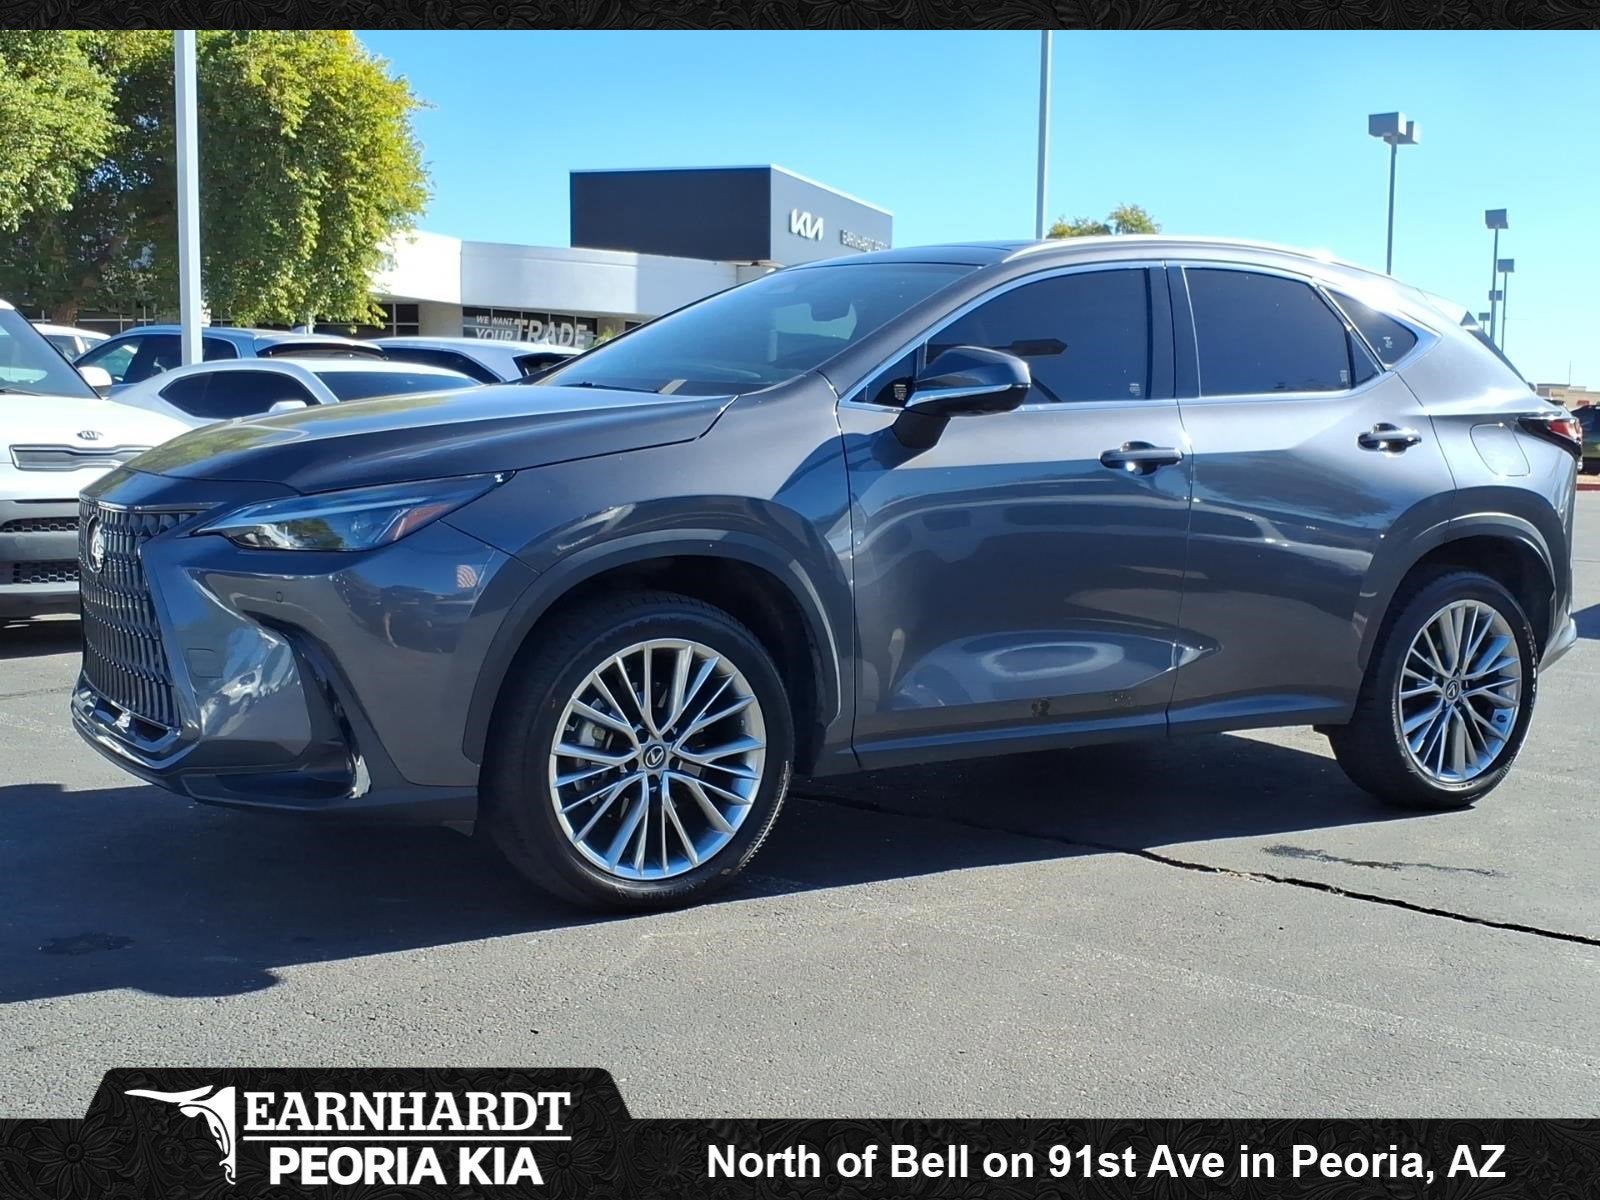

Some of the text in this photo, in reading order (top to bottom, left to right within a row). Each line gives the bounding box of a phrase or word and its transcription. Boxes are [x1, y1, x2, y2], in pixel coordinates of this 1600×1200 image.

[791, 208, 824, 241] KIA
[475, 315, 513, 327] WE WANT
[475, 318, 588, 348] YOUR TRADE
